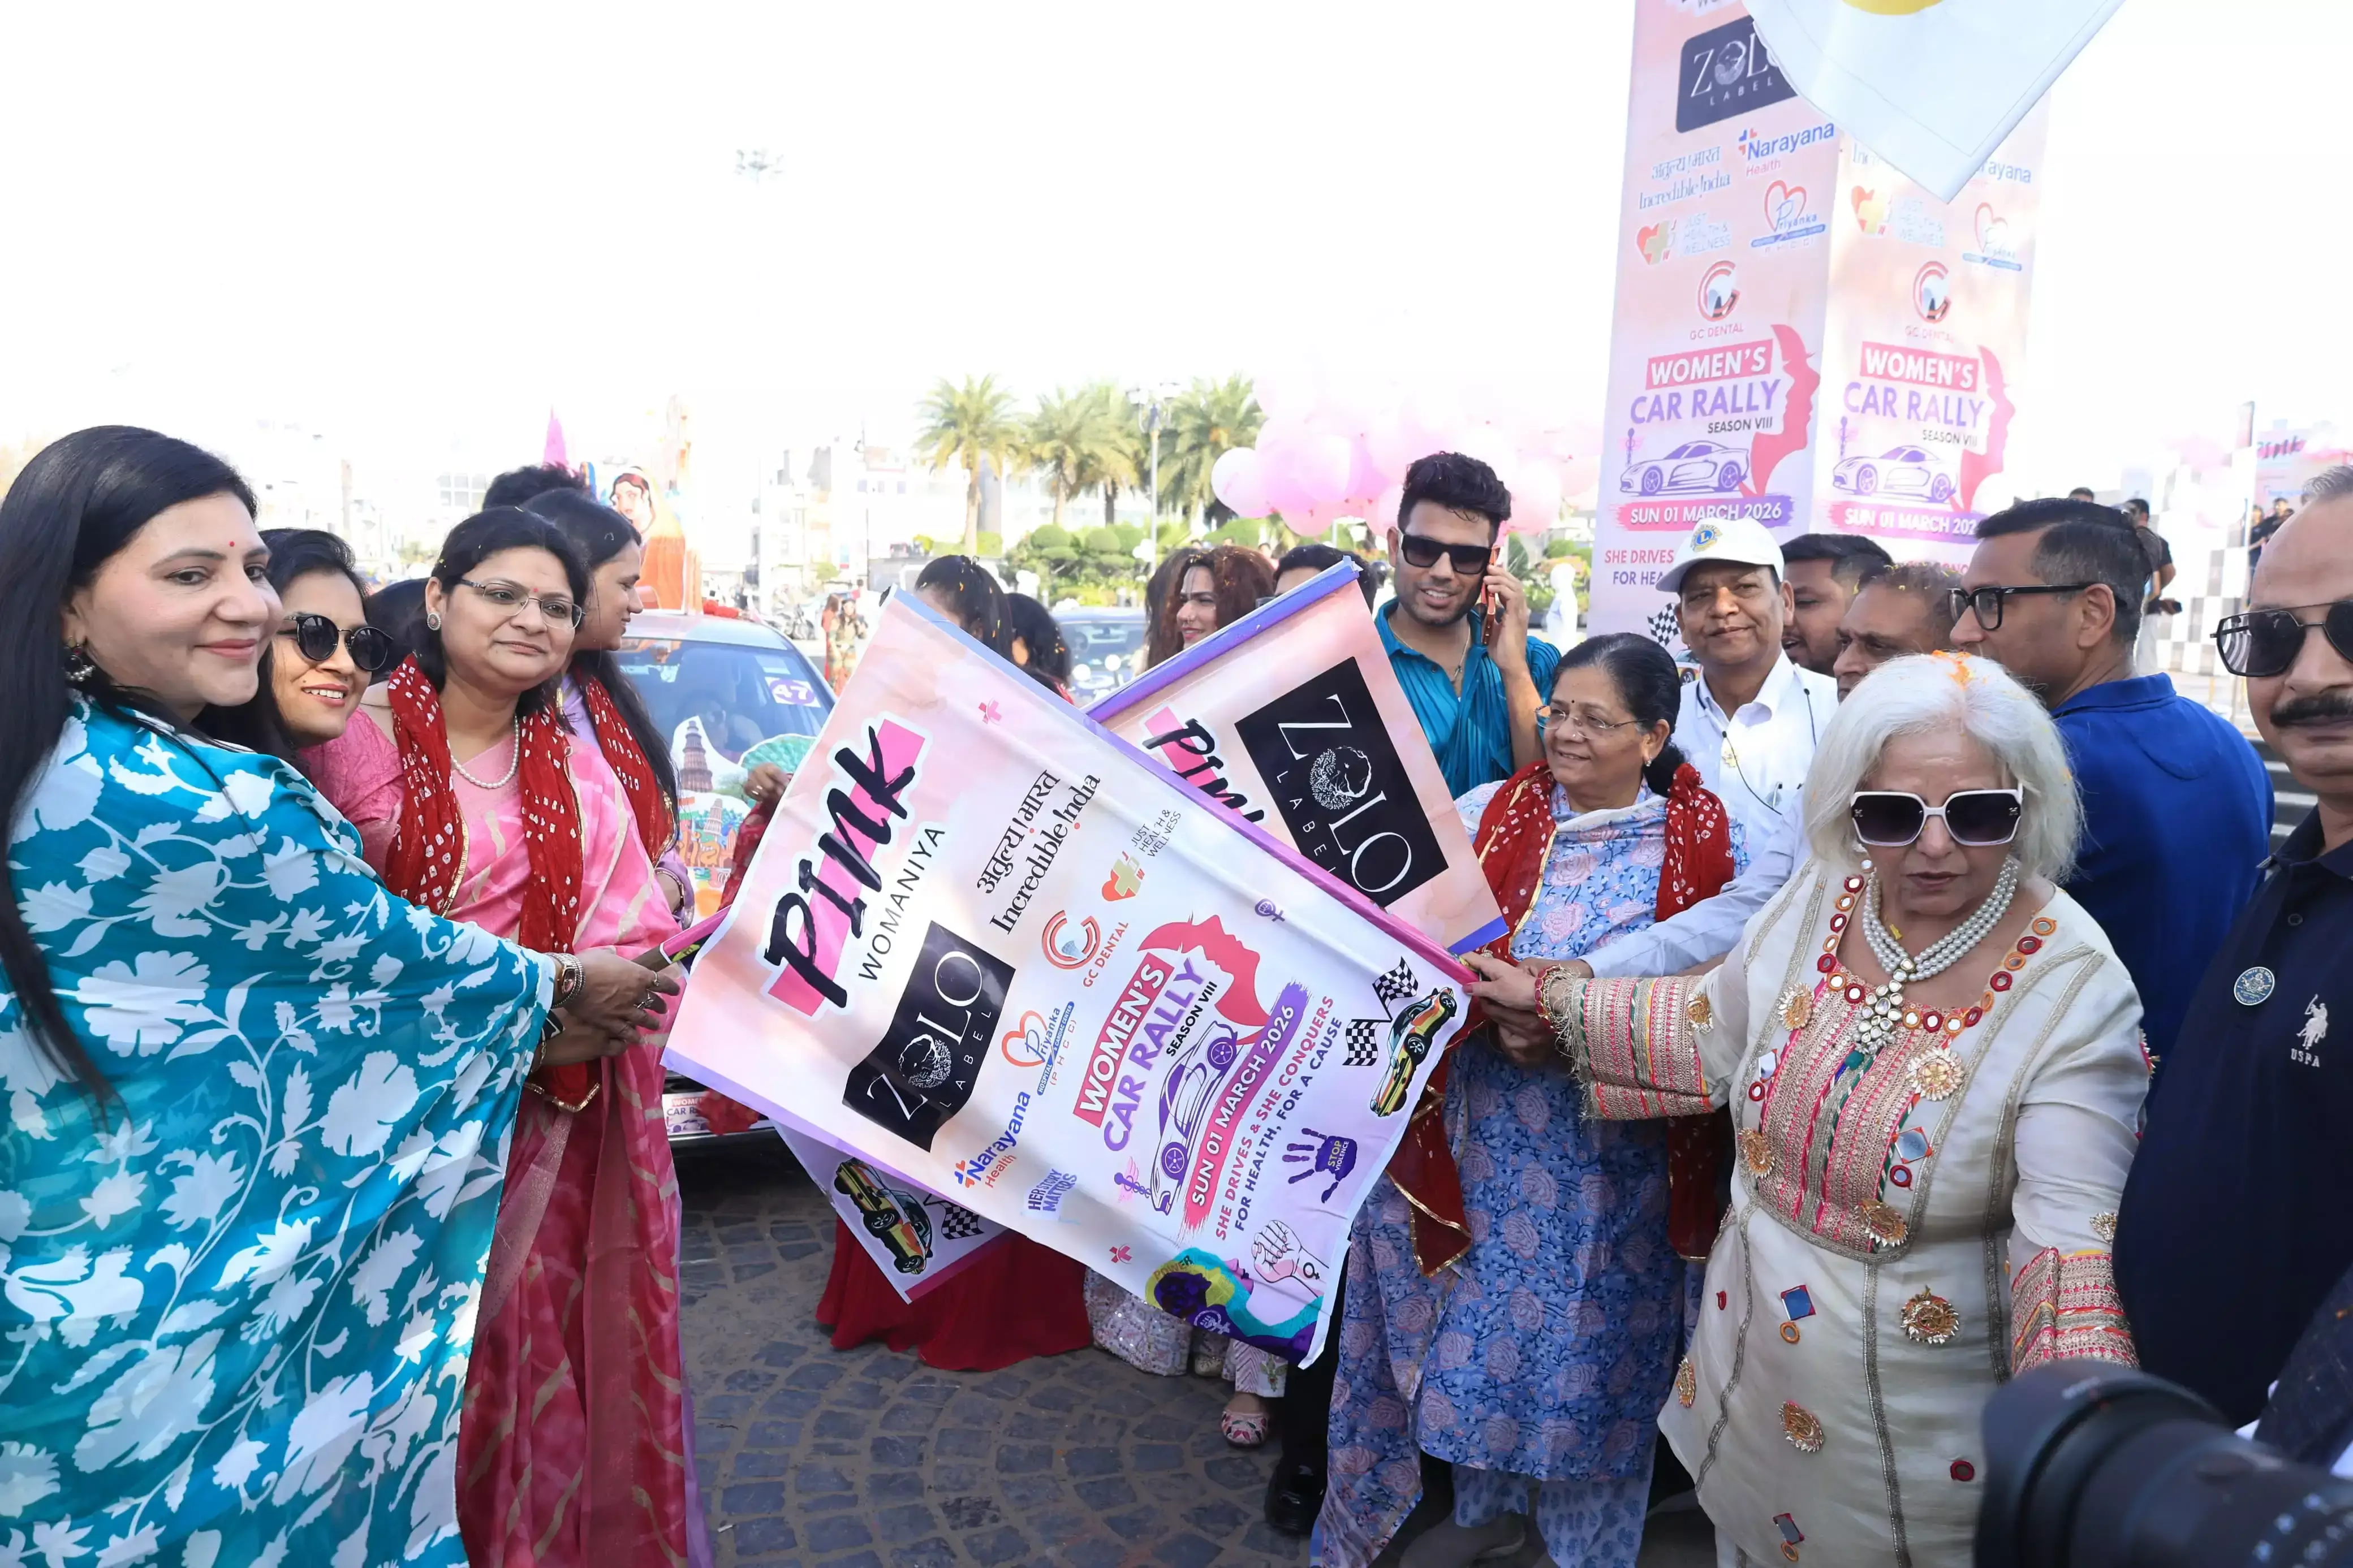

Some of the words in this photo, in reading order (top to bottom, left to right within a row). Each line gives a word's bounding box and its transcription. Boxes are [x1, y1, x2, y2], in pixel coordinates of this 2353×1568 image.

[1710, 76, 1773, 106] LABEL
[1748, 123, 1834, 161] Narayana
[1746, 159, 1781, 177] Health
[1639, 178, 1700, 210] Incredible
[1690, 329, 1706, 340] GC
[1707, 323, 1744, 338] DENTAL
[1650, 346, 1767, 386] WOMEN'S
[1865, 348, 1974, 389] WOMEN'S
[1630, 391, 1683, 424] CAR
[1691, 378, 1782, 418] RALLY
[1843, 381, 1898, 418] CAR
[1907, 389, 1985, 429] RALLY
[1707, 418, 1752, 434] SEASON
[1755, 416, 1773, 430] VIII
[1922, 429, 1960, 444] SEASON
[1630, 507, 1660, 524] SUN
[1664, 508, 1678, 522] 01
[1682, 503, 1740, 521] MARCH
[1744, 502, 1782, 520] 2026
[1845, 508, 1876, 526] SUN
[1880, 511, 1895, 529] 01
[1898, 512, 1950, 534] MARCH
[1952, 517, 1978, 535] 202
[1604, 550, 1627, 564] SHE
[1630, 548, 1674, 564] DRIVES
[1613, 571, 1636, 585] FOR
[1142, 718, 1265, 823] PIN
[1131, 823, 1150, 847] JUST
[1139, 817, 1166, 853] HEALH
[764, 725, 916, 1009] PINK
[989, 823, 1068, 935] Incredible
[858, 828, 945, 980] WOMANIYA
[1083, 969, 1099, 988] GC
[1094, 921, 1129, 969] DENTAL
[1024, 1007, 1061, 1062] Priyanka
[1079, 963, 1165, 1113] WOMEN'S
[1166, 1004, 1203, 1057] SEASON
[1197, 980, 1218, 1005] VIII
[1260, 1005, 1295, 1055] 2026
[939, 1010, 992, 1108] LABEL
[1037, 1062, 1053, 1093] HOSPITAL
[1054, 1024, 1066, 1047] CARDIAC
[1061, 1005, 1074, 1025] CENTER
[1103, 1074, 1148, 1152] CAR
[1128, 957, 1205, 1072] RALLY
[2290, 1048, 2320, 1068] USPA
[1214, 1055, 1267, 1129] MARCH
[666, 1108, 687, 1116] CAR
[1216, 1204, 1233, 1241] SHE
[1225, 1136, 1252, 1203] DRIVES
[1250, 1123, 1261, 1134] &
[1256, 1088, 1282, 1121] SHE
[1278, 996, 1334, 1087] CONQUERS
[1235, 1195, 1252, 1232] FOR
[1244, 1125, 1282, 1193] HEALTH,
[1276, 1089, 1303, 1121] FOR
[1300, 1075, 1313, 1088] A
[1309, 1017, 1343, 1070] CAUSE
[967, 1091, 1031, 1181] Narayana
[1206, 1132, 1225, 1155] 01
[1328, 1140, 1342, 1167] STOP
[985, 1154, 1017, 1189] Health
[1334, 1140, 1350, 1172] VIOLENCE
[1042, 1173, 1078, 1212] MATTERS
[1192, 1160, 1215, 1207] SUN
[1153, 1254, 1194, 1281] POWER
